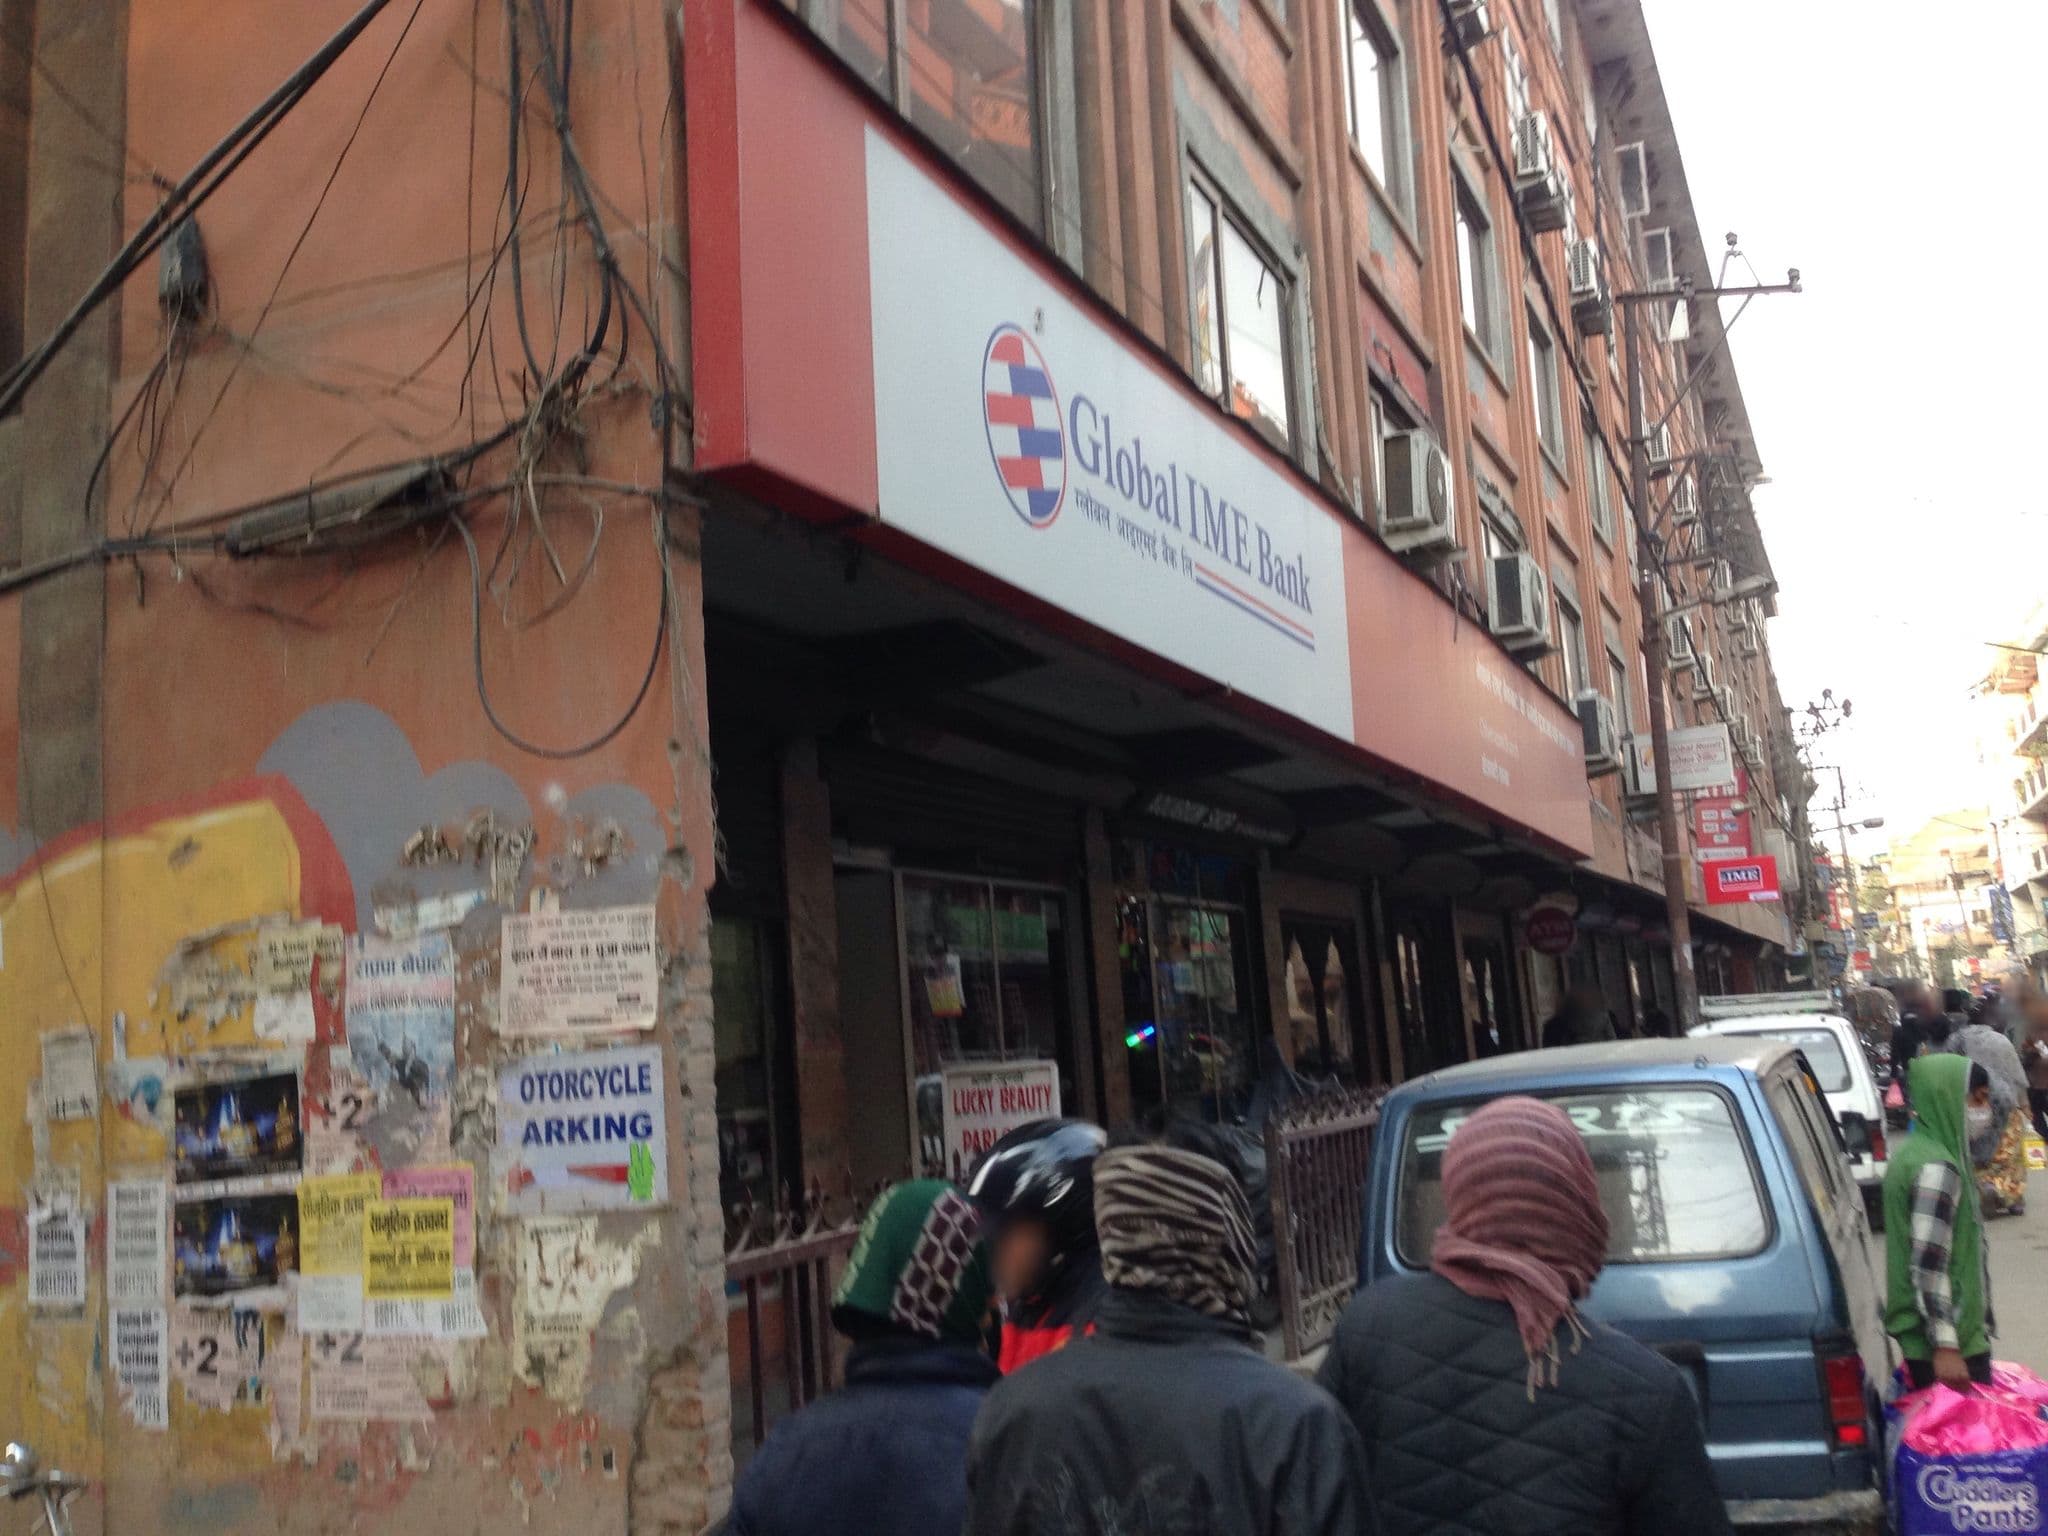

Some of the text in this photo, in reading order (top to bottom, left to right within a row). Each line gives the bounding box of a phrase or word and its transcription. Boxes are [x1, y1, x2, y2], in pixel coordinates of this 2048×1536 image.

[1069, 393, 1313, 616] Global IME Bank
[1726, 866, 1760, 883] IME
[953, 1084, 1051, 1116] LUCKY BEAUTY
[1951, 1504, 2041, 1534] Pants
